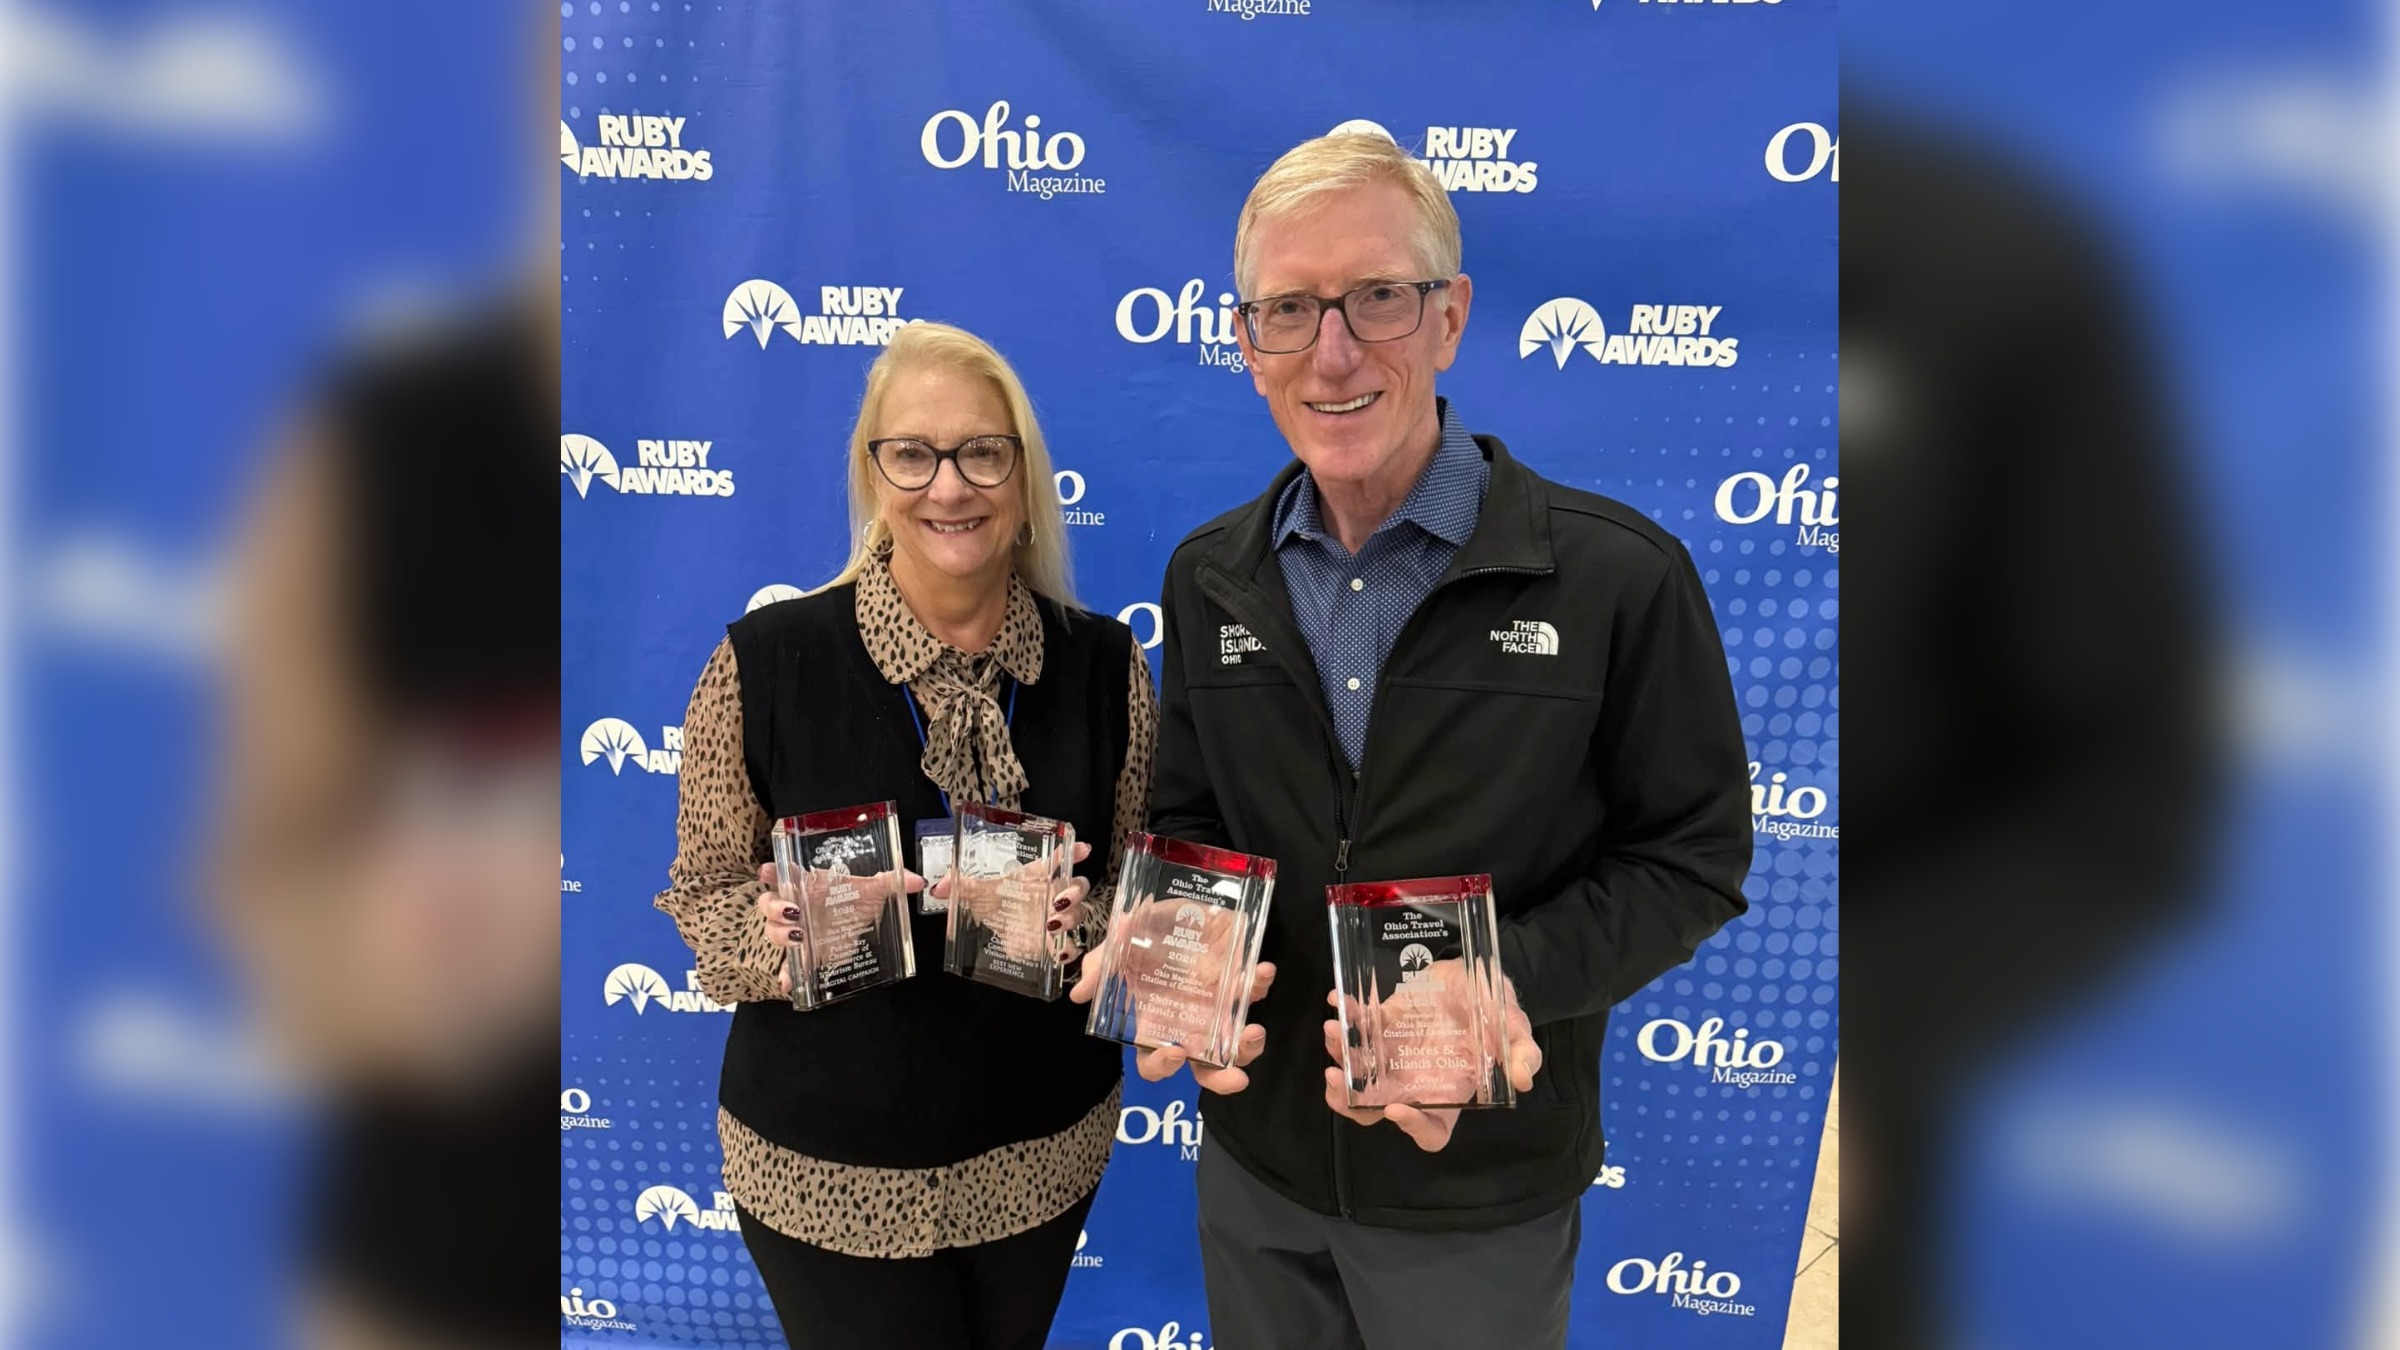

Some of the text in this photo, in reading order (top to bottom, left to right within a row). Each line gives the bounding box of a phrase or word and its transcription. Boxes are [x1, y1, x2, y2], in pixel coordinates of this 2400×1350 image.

[599, 114, 686, 148] RUBY
[920, 100, 1086, 170] Ohio
[1426, 126, 1517, 159] RUBY
[580, 147, 713, 181] AWARDS
[1007, 169, 1105, 199] Magazine
[1421, 159, 1538, 193] WARDS
[821, 286, 904, 316] RUBY
[1115, 278, 1238, 344] Ohi
[801, 316, 908, 345] AWAR
[1629, 304, 1722, 335] RUBY
[1601, 335, 1739, 368] AWARDS
[637, 439, 712, 468] RUBY
[619, 467, 735, 497] AWARDS
[1714, 462, 1839, 526] Ohi
[1220, 624, 1251, 638] SHOR
[1489, 630, 1537, 643] NORTH
[1512, 620, 1539, 632] THE
[1221, 636, 1267, 654] ISLAND
[1502, 641, 1536, 654] FACE
[1171, 878, 1194, 890] Ohio
[1191, 873, 1209, 884] The
[1166, 886, 1227, 906] Association's
[1384, 920, 1445, 932] Ohio Travel
[1402, 911, 1423, 921] The
[1172, 925, 1204, 941] RUBY
[1381, 928, 1449, 941] Association's
[1138, 1000, 1206, 1026] Islands Ohio
[1148, 992, 1185, 1011] Shores
[1397, 1044, 1439, 1057] Shores
[1637, 1017, 1784, 1069] Ohio
[1389, 1056, 1468, 1071] Islands Ohio
[1711, 1067, 1797, 1089] Magazine
[561, 1114, 611, 1130] gazine
[1115, 1100, 1204, 1146] Ohi
[1606, 1251, 1741, 1298] Ohio
[1671, 1293, 1756, 1316] Magazine
[565, 1315, 638, 1331] Magazine
